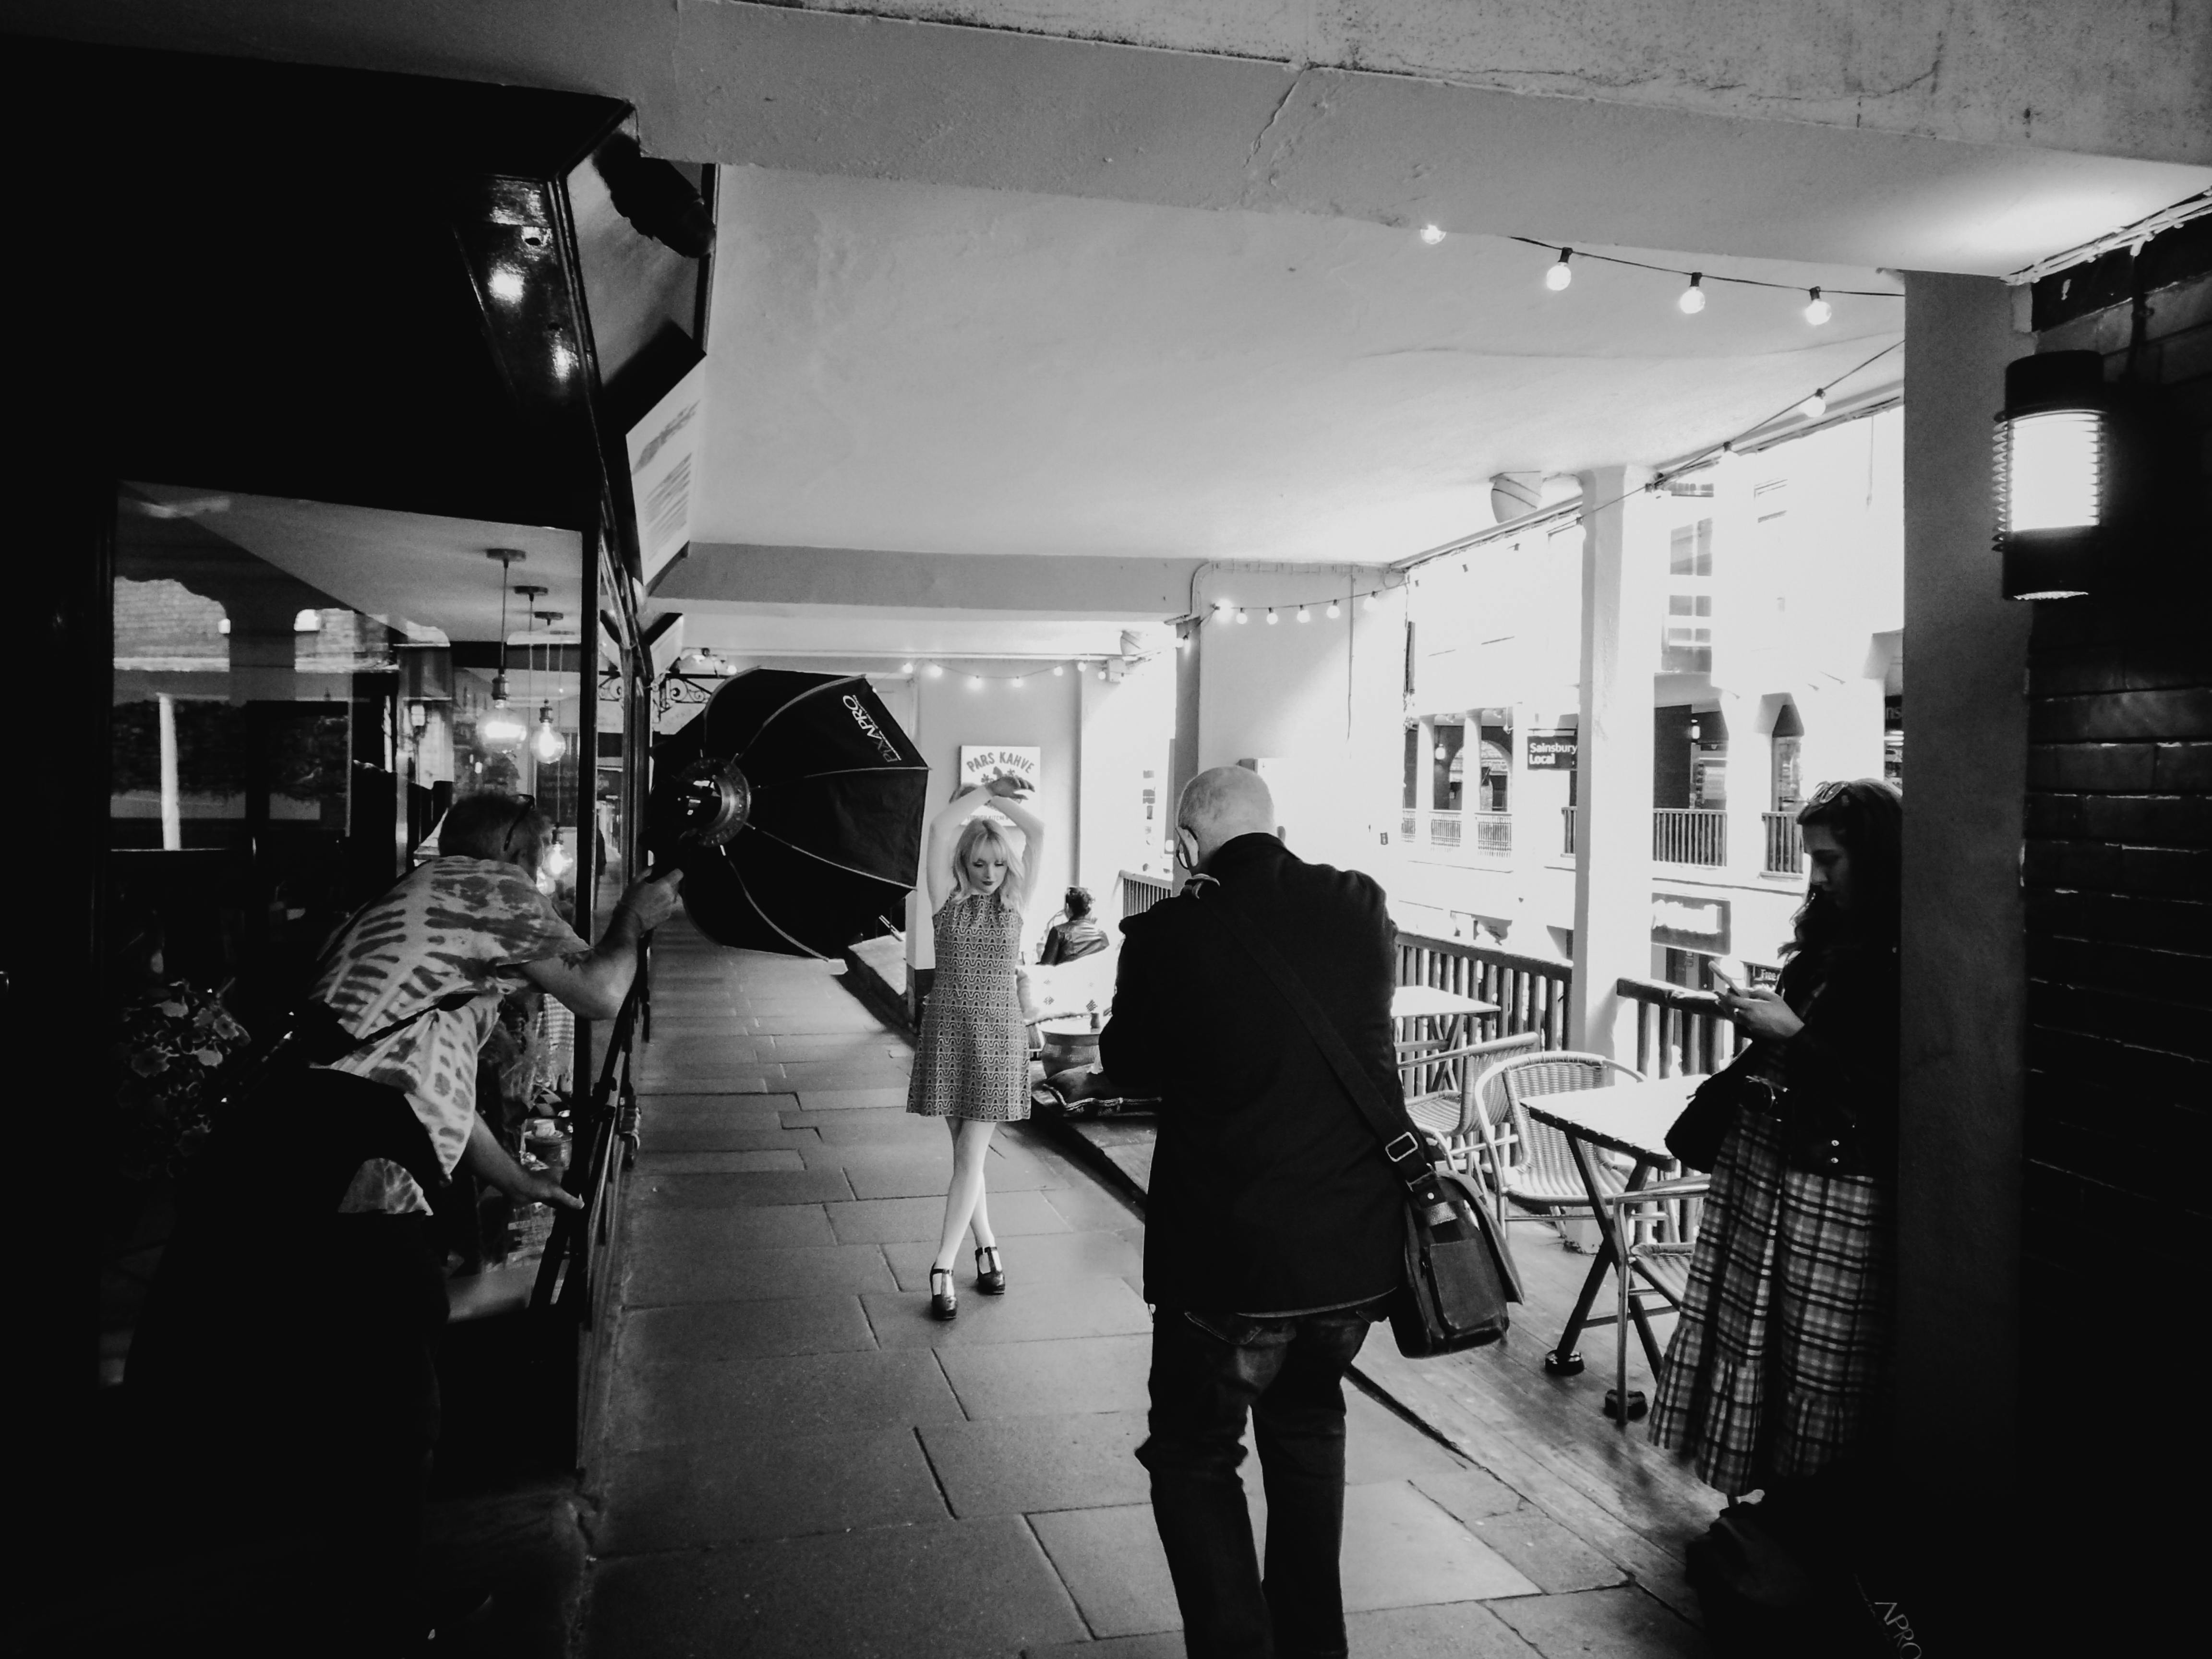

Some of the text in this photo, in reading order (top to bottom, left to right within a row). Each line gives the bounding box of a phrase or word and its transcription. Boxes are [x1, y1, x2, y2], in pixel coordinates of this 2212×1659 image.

[843, 695, 898, 762] PIXAPRO
[967, 751, 1035, 773] PARS KAHVE
[1529, 753, 1555, 764] Local
